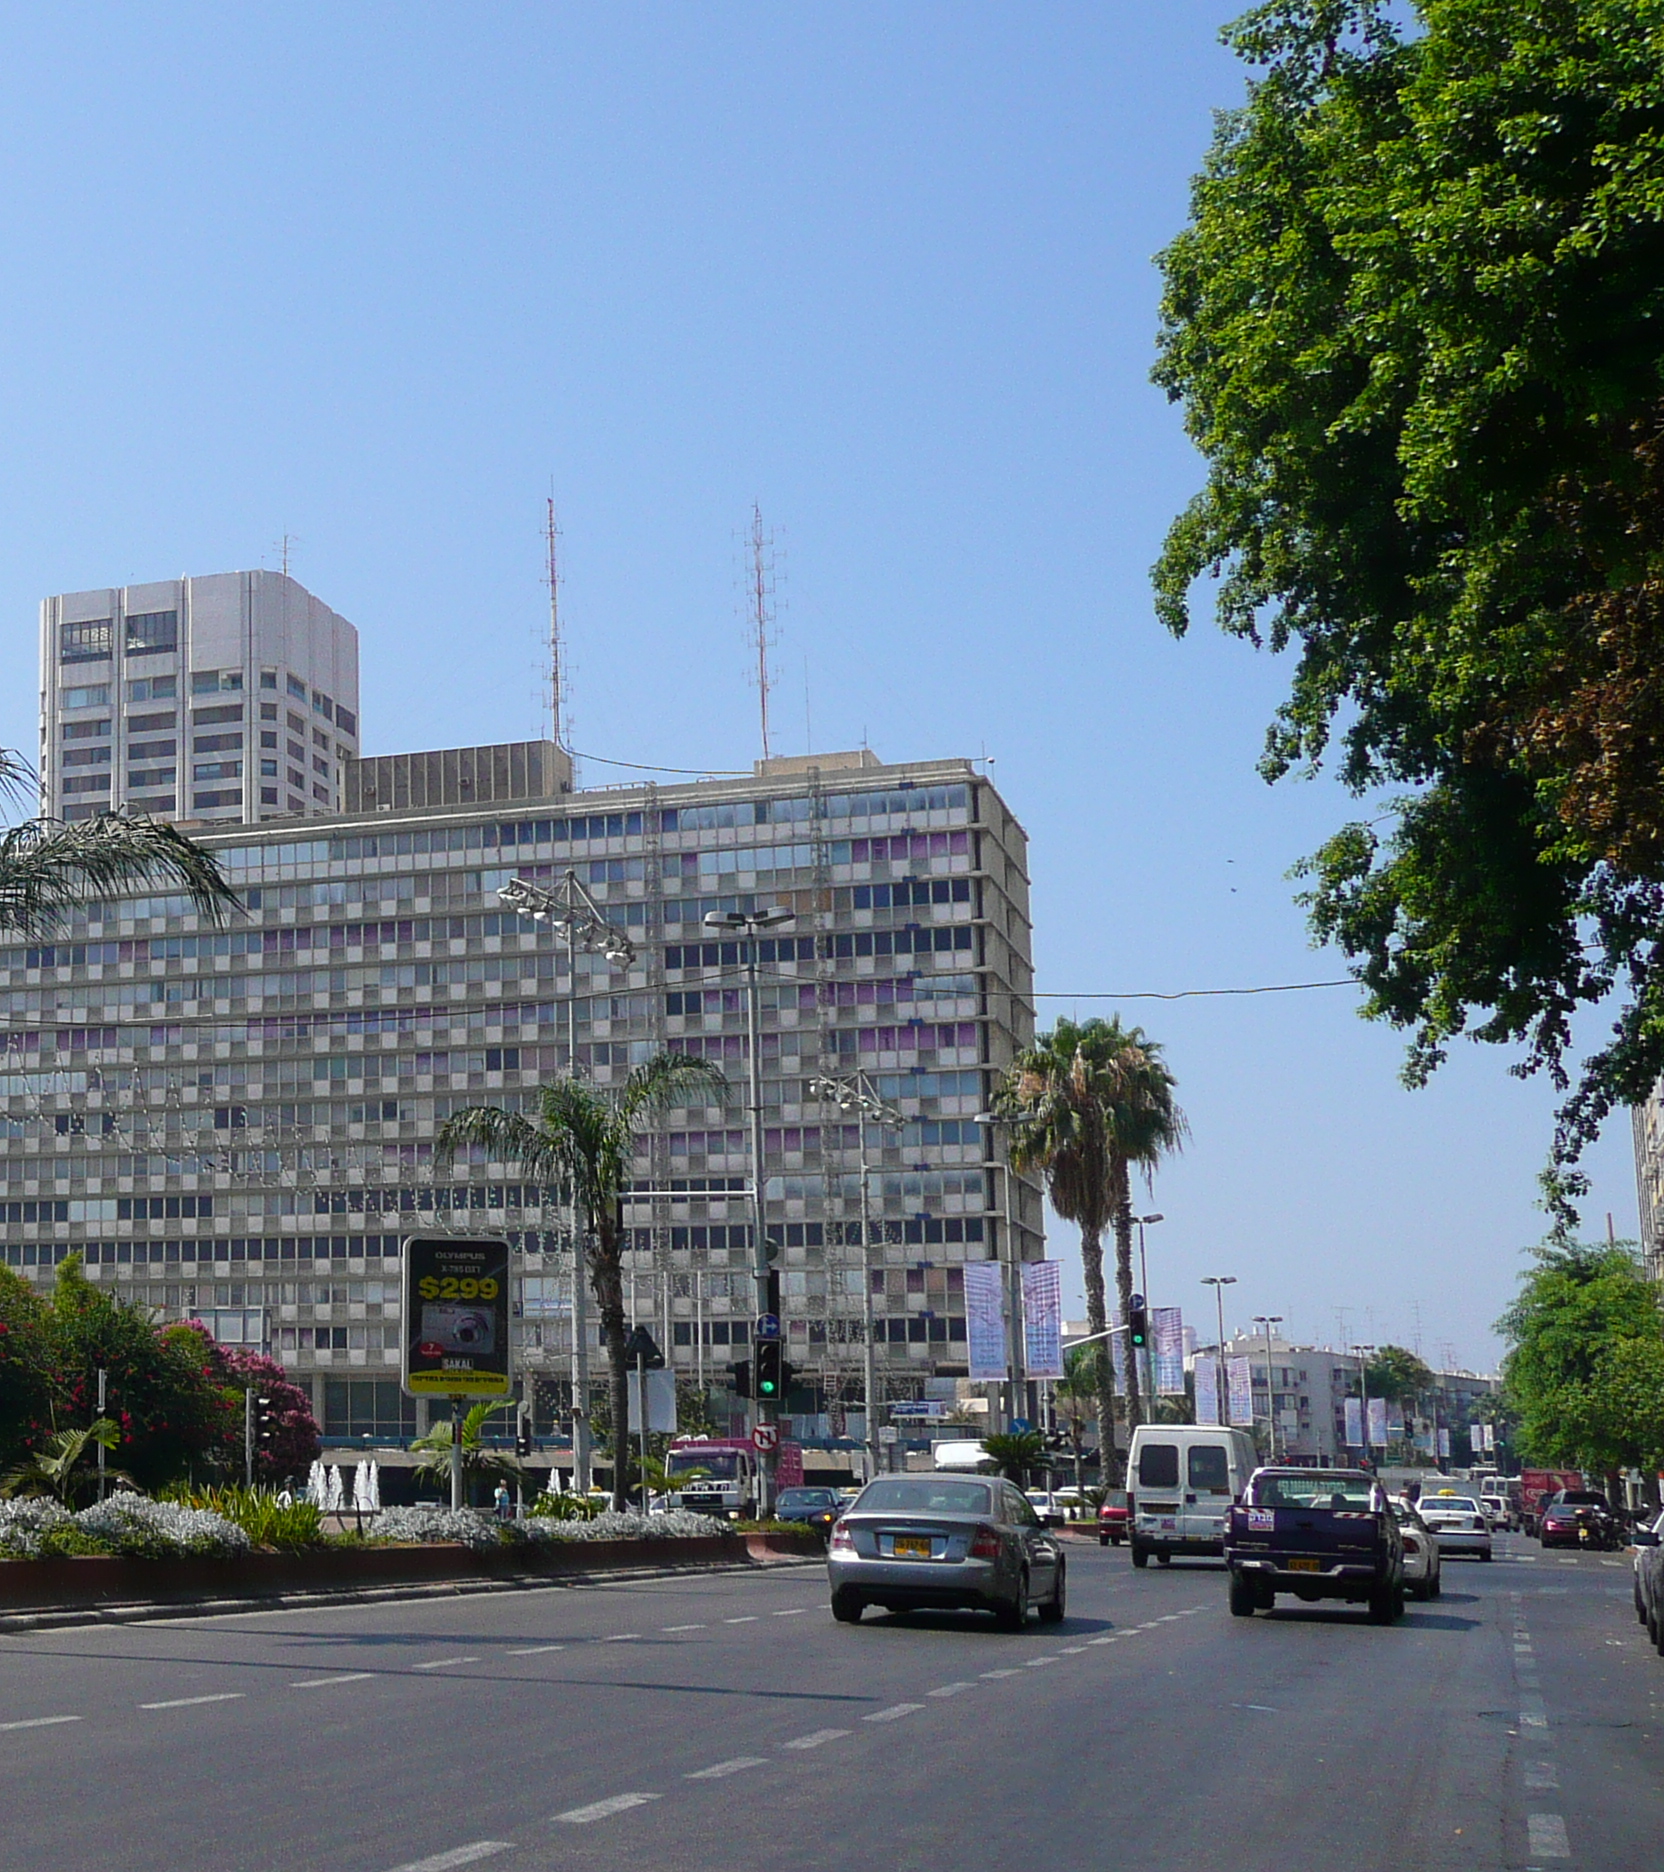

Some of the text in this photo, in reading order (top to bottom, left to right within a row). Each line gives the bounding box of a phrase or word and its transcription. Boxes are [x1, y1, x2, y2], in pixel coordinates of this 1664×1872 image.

[435, 1251, 486, 1260] OLYMPUS
[418, 1275, 499, 1300] $299
[443, 1358, 473, 1370] SAKAL
